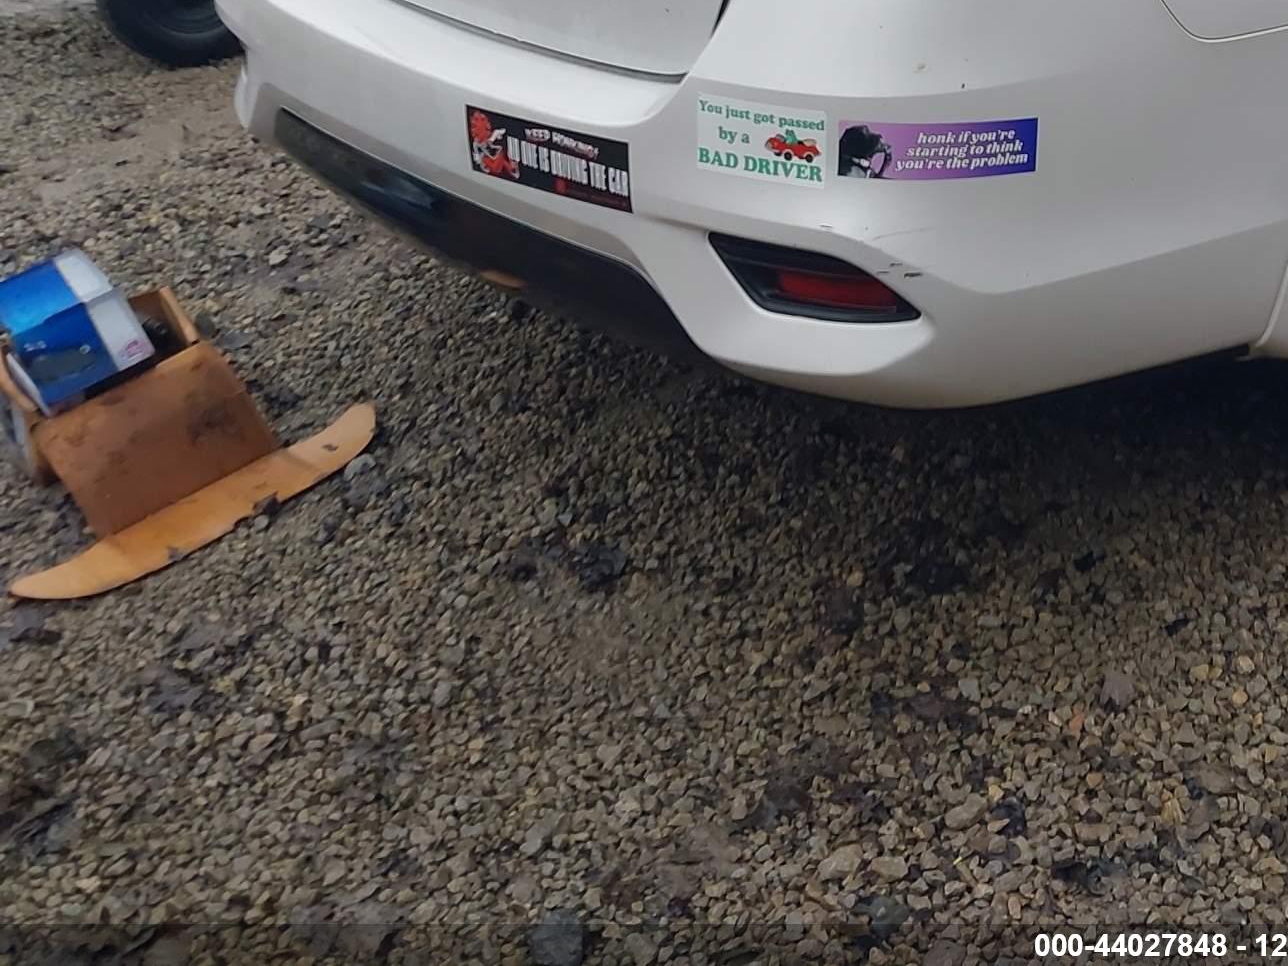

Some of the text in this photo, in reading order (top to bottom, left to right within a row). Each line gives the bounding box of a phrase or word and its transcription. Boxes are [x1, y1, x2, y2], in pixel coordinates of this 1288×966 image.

[699, 99, 825, 131] You just got passed
[718, 126, 750, 144] by a
[917, 129, 1016, 144] honk if you're
[906, 139, 1023, 158] starting to think
[698, 147, 823, 182] BAD DRIVER
[895, 153, 1029, 171] you're the problem
